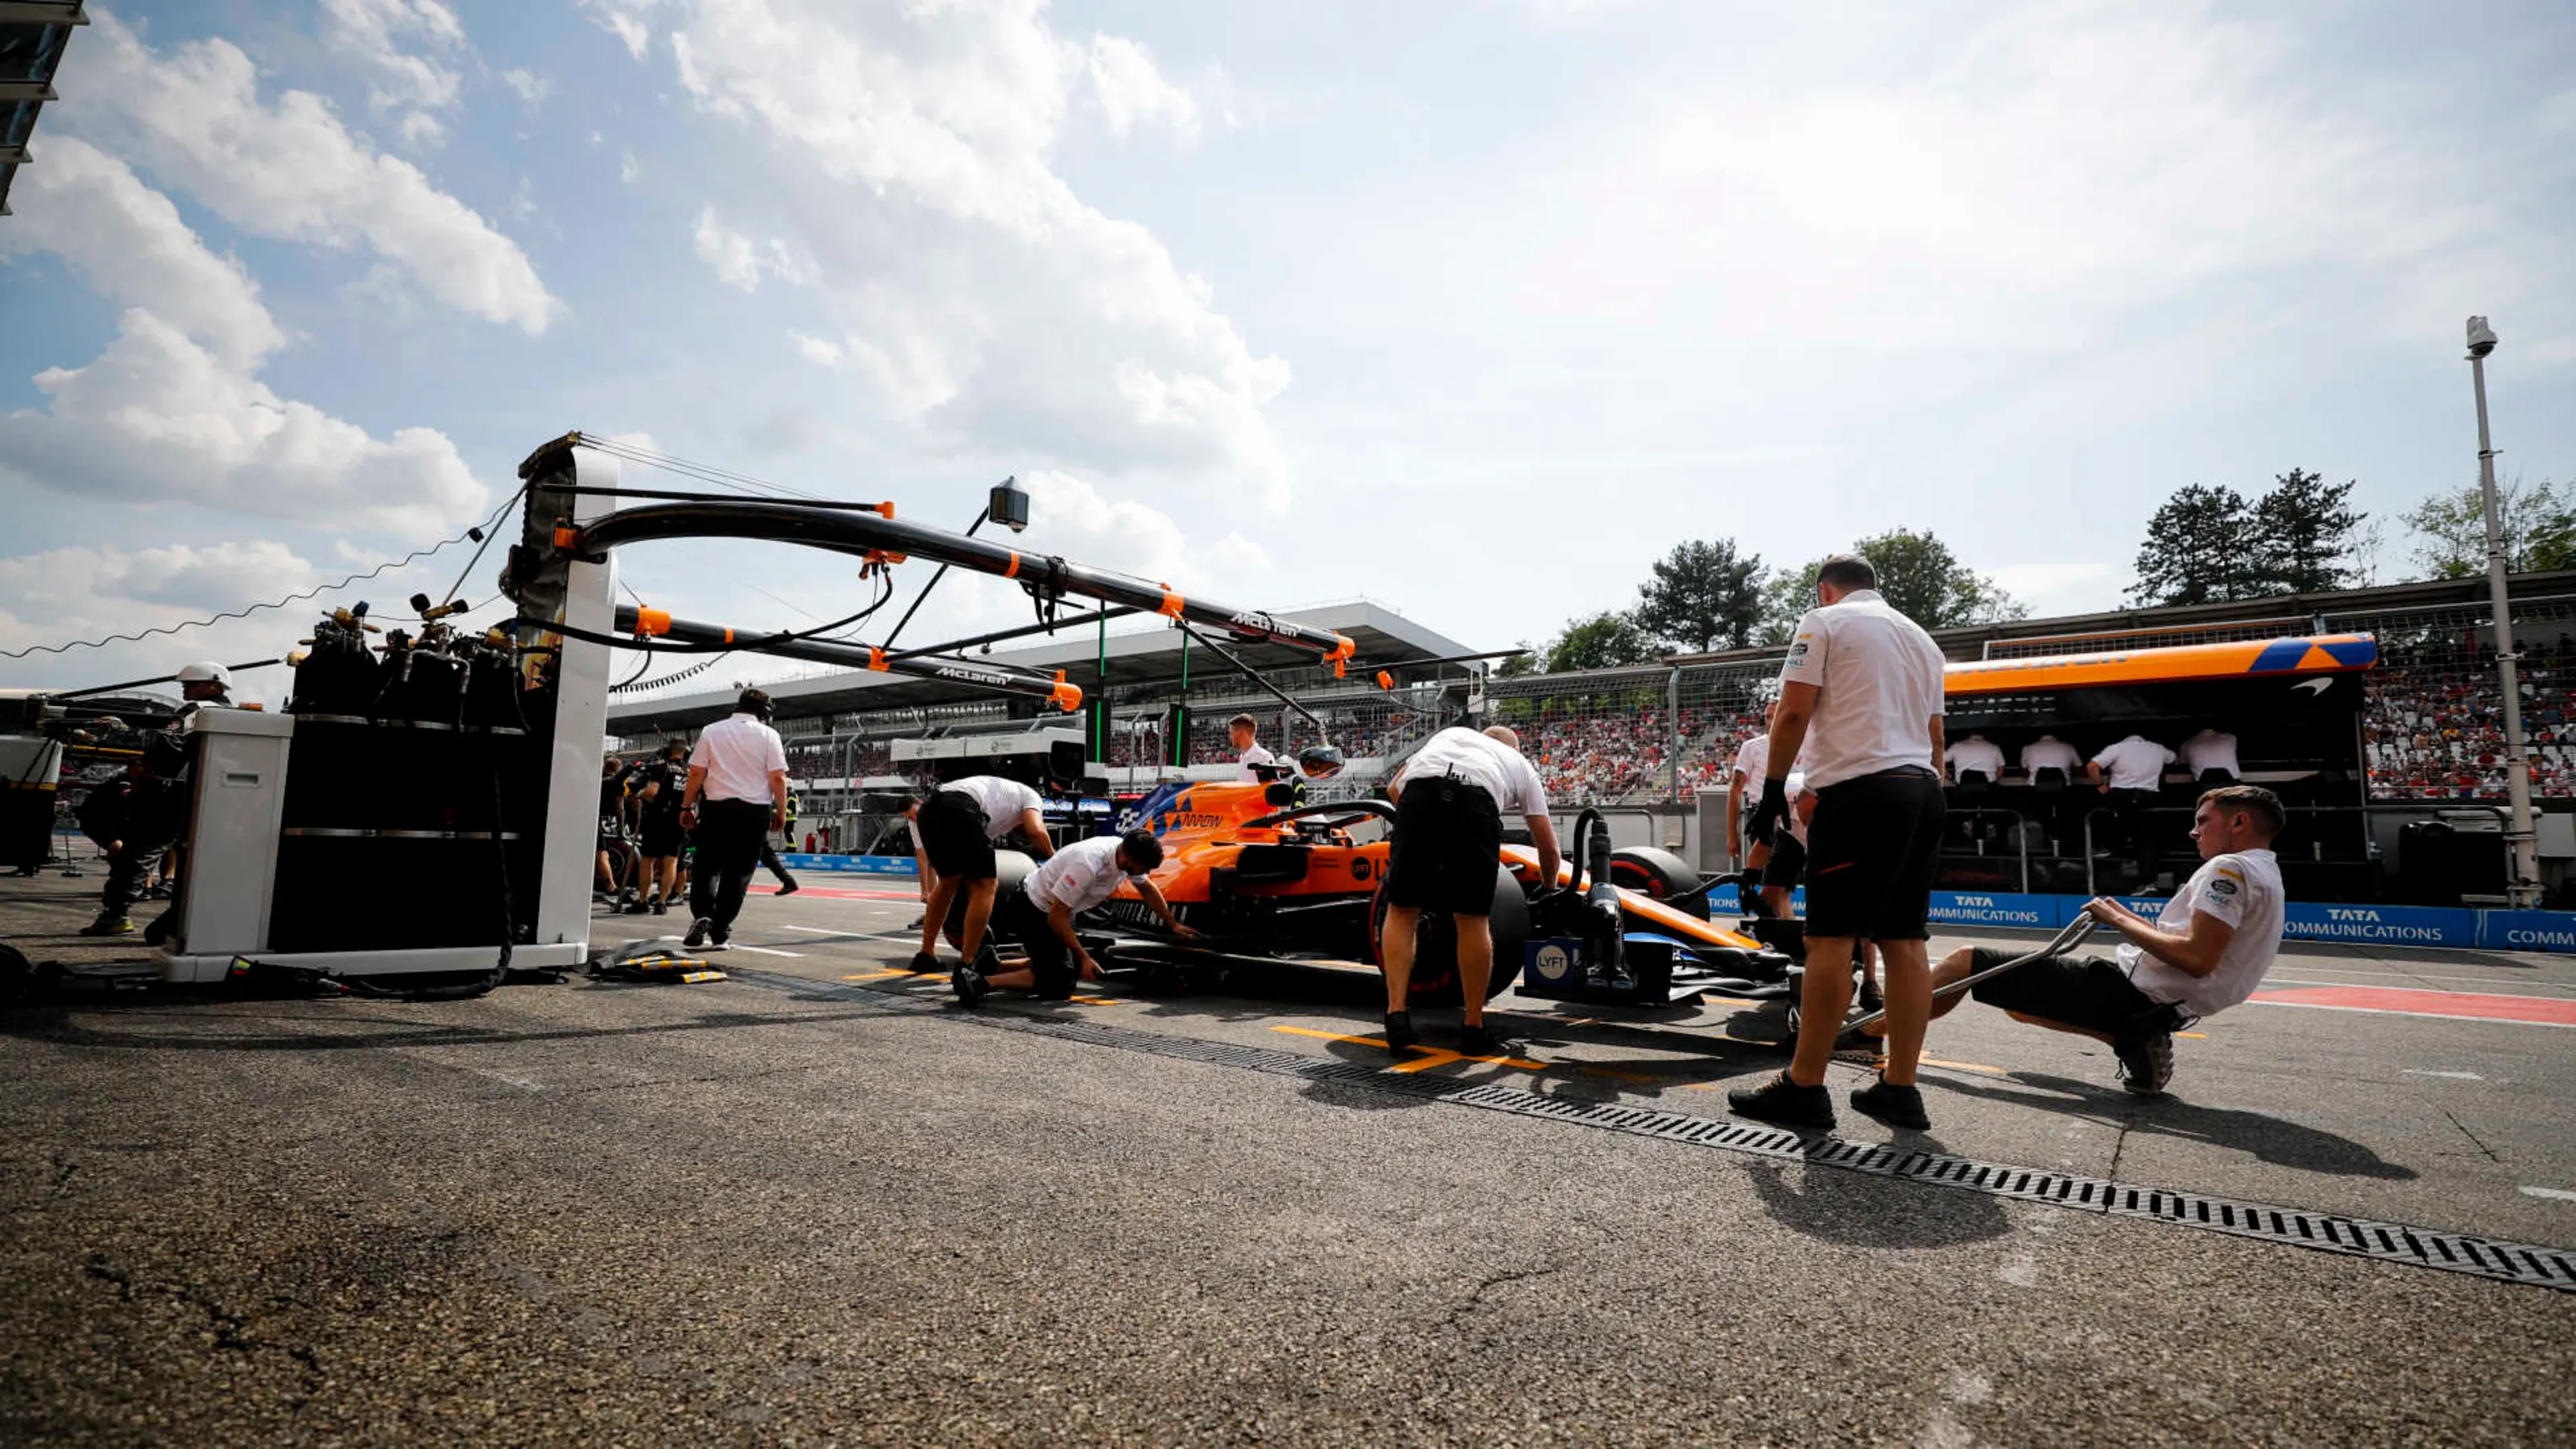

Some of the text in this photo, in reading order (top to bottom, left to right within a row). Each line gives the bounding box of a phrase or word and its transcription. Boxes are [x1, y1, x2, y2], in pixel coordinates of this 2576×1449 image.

[1230, 613, 1299, 637] McLaren
[935, 667, 1007, 685] McLaren
[1115, 808, 1140, 834] 55
[1182, 813, 1223, 828] ARROW
[1954, 895, 1995, 907] TATA
[2130, 902, 2167, 913] TAT
[2326, 909, 2381, 922] TATA
[1538, 954, 1564, 968] LYFT
